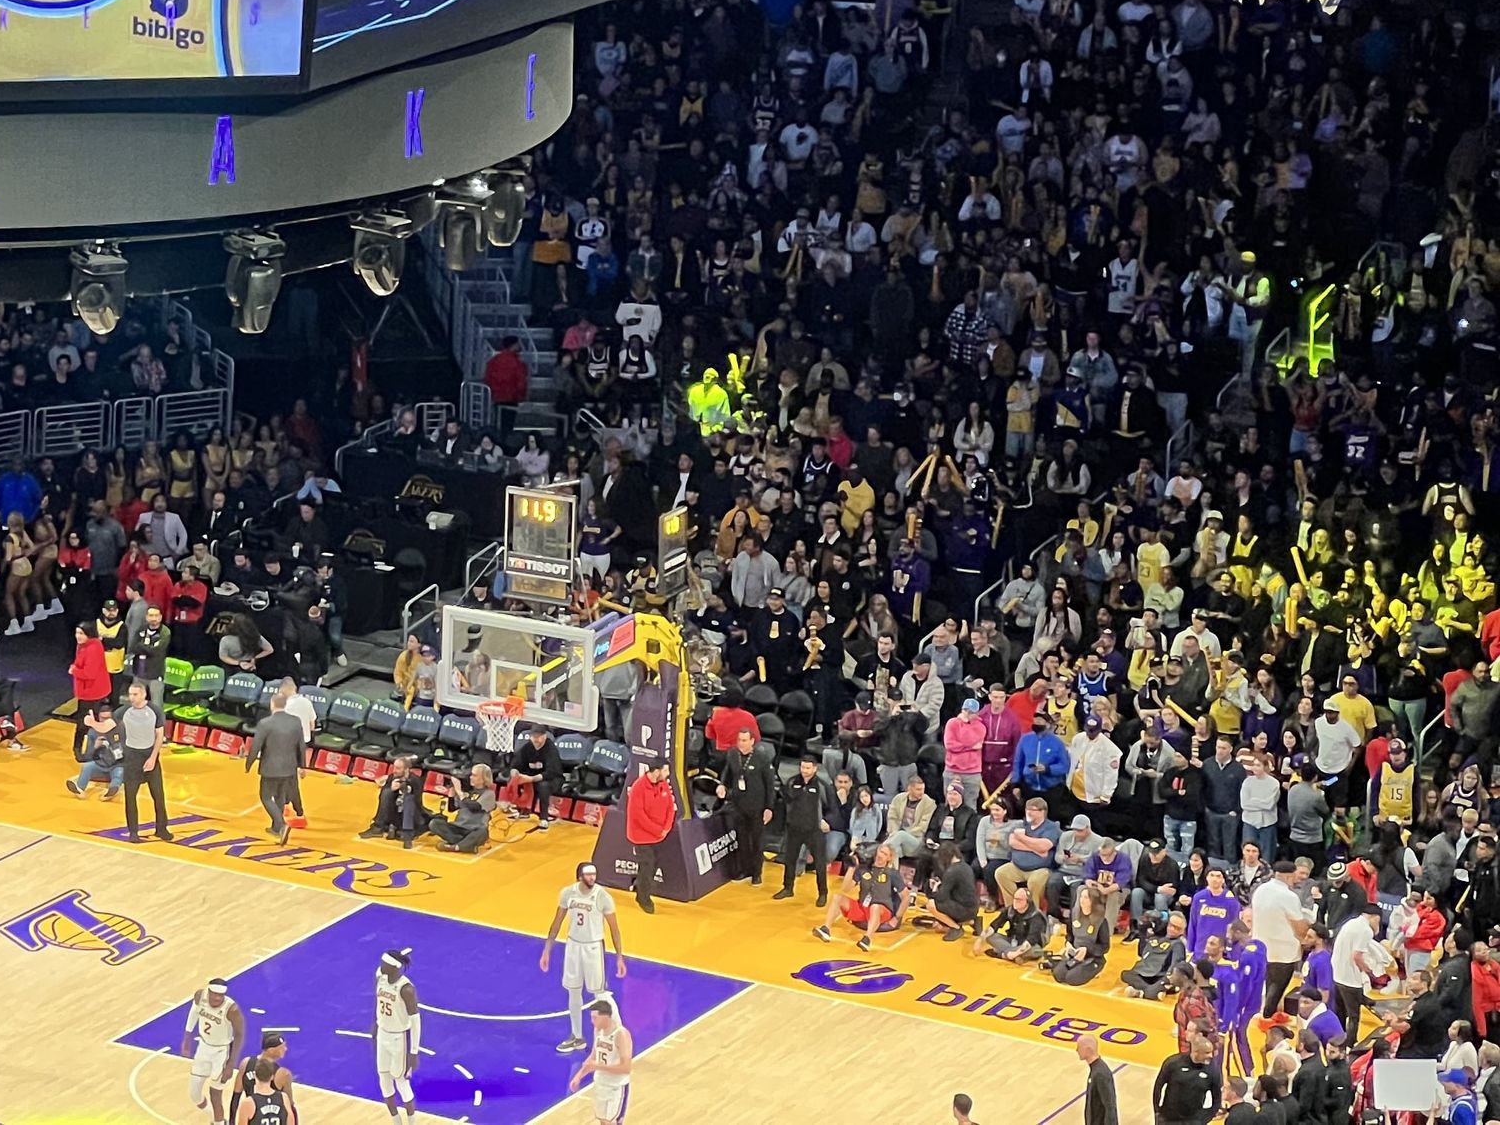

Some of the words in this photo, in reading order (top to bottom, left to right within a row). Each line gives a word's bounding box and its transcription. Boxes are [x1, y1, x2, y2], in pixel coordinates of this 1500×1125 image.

[132, 16, 206, 50] bibigo
[524, 557, 570, 576] TISSOT
[196, 671, 220, 681] DELTA
[234, 679, 257, 689] DELTA
[342, 699, 364, 711] DELTA
[377, 705, 400, 719] DELTA
[412, 713, 436, 723] DELTA
[451, 720, 475, 733] DELTA
[558, 740, 583, 750] DELTA
[599, 748, 624, 762] DELTA
[1390, 787, 1403, 801] 15
[71, 814, 443, 898] LAKERS
[576, 912, 585, 926] 3
[379, 1001, 393, 1017] 35
[915, 983, 1148, 1045] bibigo
[203, 1021, 212, 1036] 2
